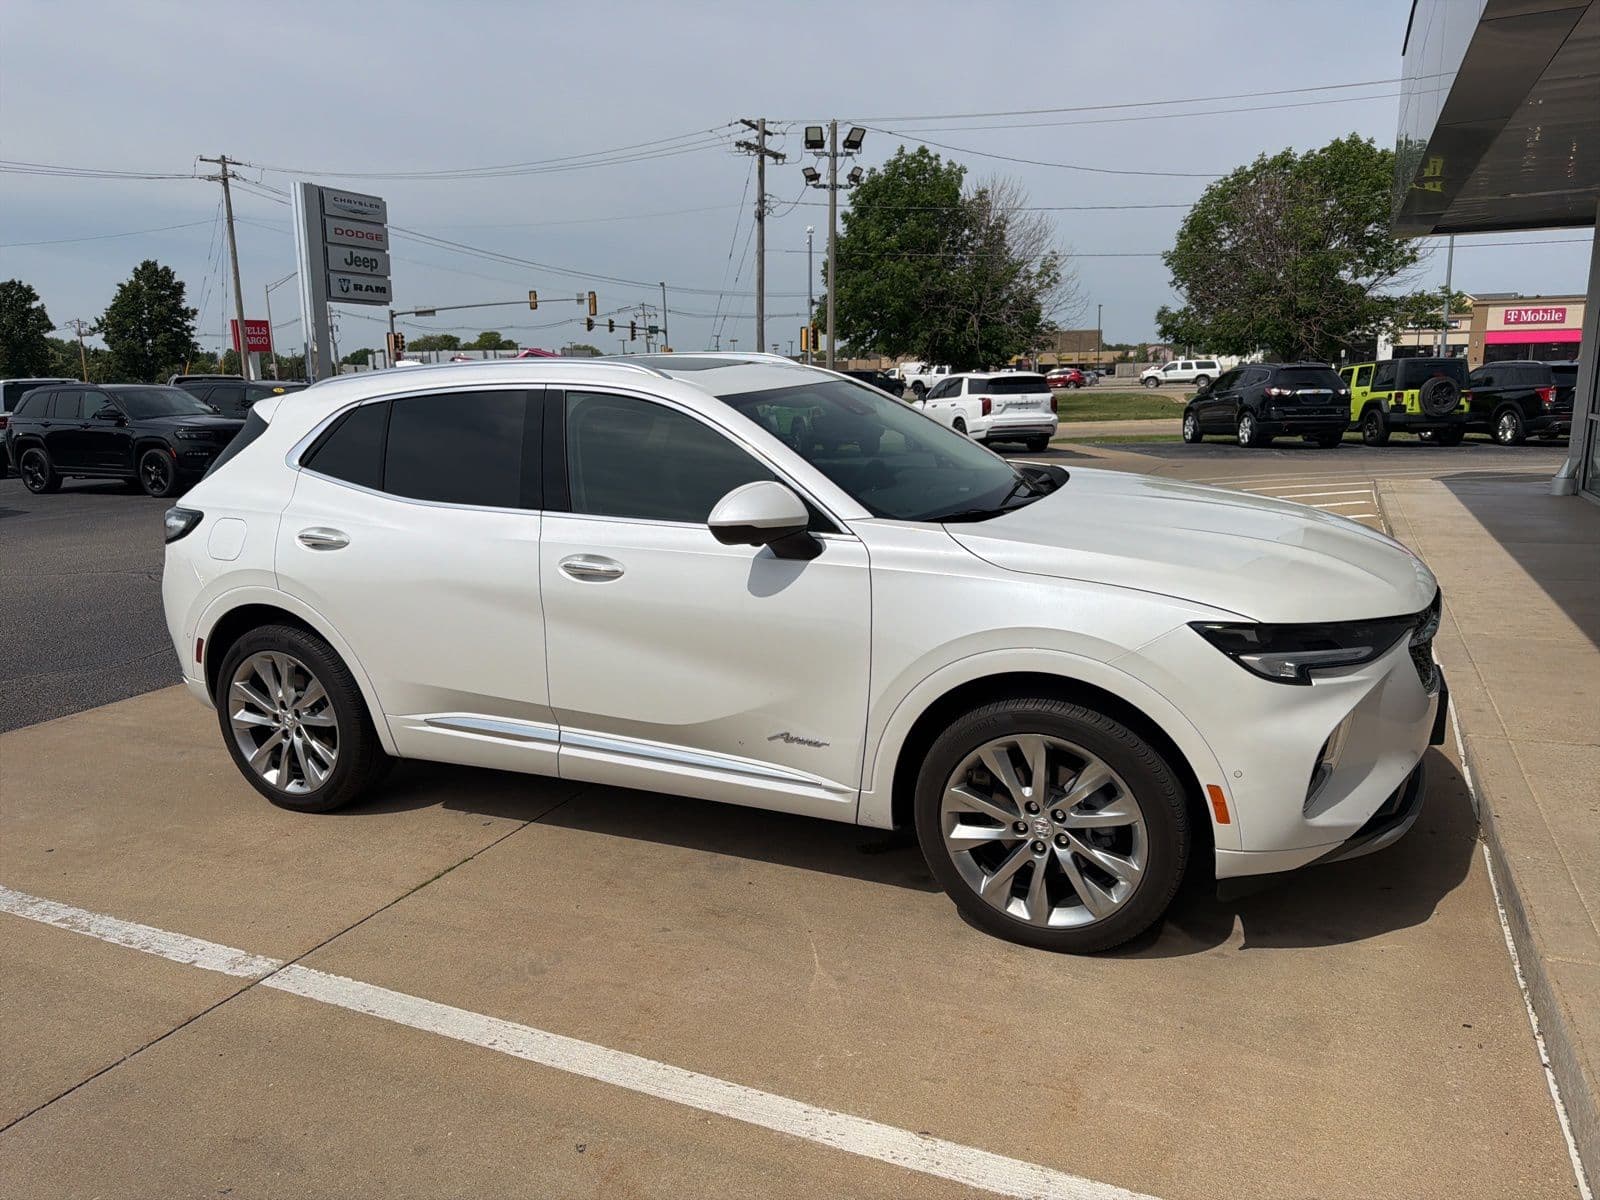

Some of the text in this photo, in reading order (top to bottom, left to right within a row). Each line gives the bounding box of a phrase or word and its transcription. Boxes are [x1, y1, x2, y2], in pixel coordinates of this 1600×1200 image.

[333, 196, 380, 209] CHRYSLER
[334, 227, 383, 241] DODGE
[344, 251, 378, 271] Jeep
[353, 283, 387, 294] RAM
[245, 327, 267, 335] ELLS
[247, 336, 268, 345] ARGO
